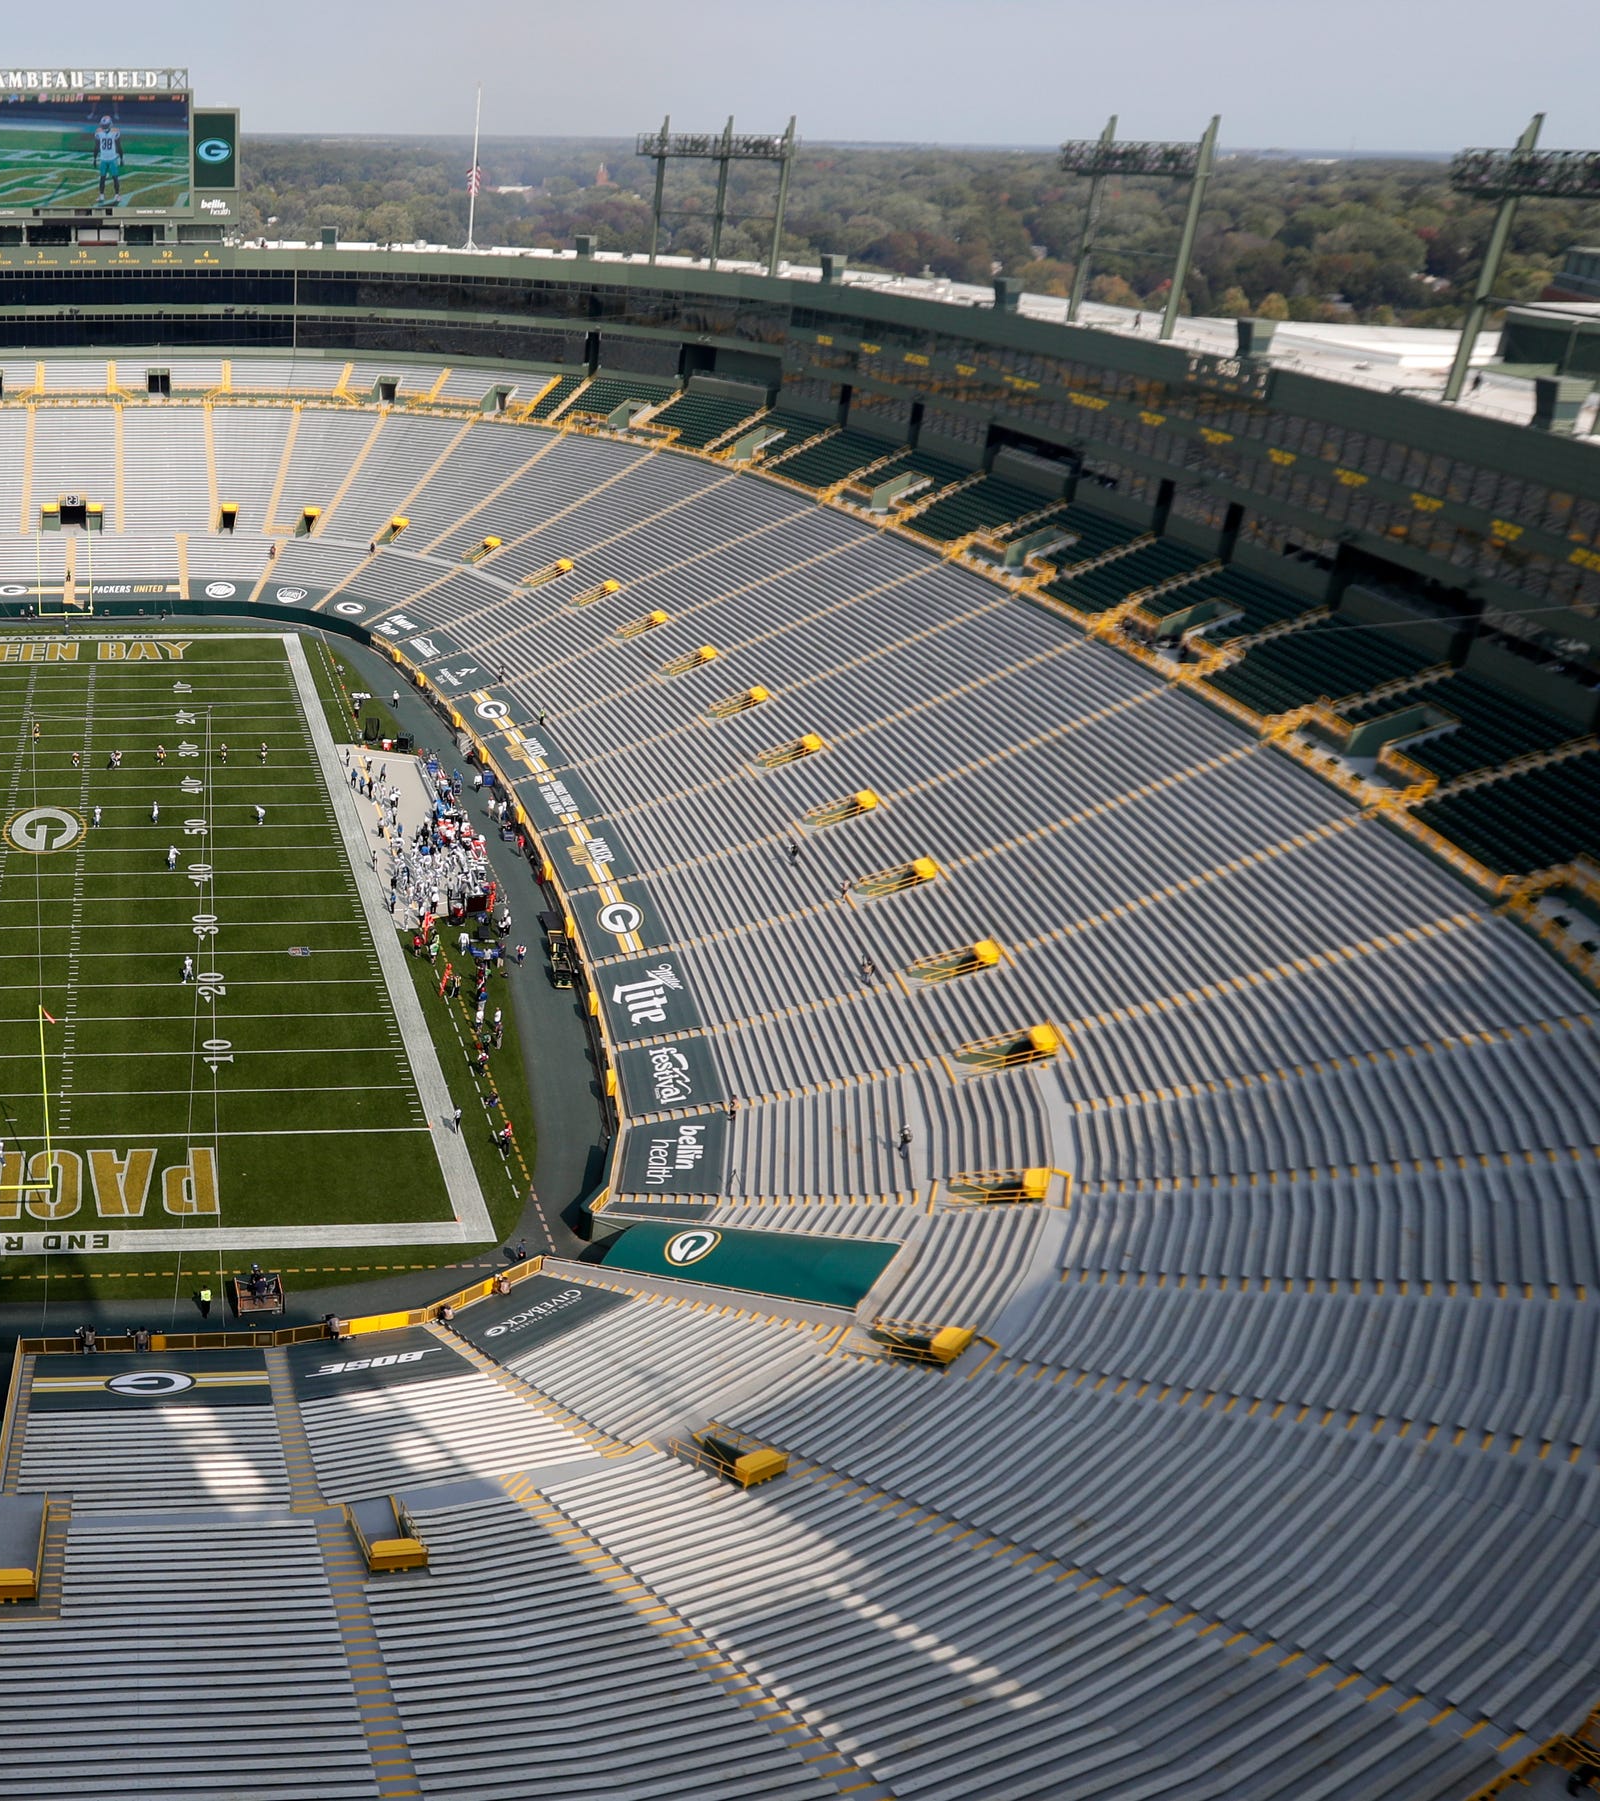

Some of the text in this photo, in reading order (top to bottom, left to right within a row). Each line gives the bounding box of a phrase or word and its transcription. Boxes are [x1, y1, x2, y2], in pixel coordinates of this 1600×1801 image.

[94, 71, 158, 88] FIELD
[196, 138, 233, 164] G
[200, 199, 226, 209] bellin
[210, 207, 231, 216] health
[38, 251, 43, 259] 3
[162, 250, 173, 258] 92
[203, 250, 209, 258] 4
[92, 584, 163, 594] PACKERS UNITED
[338, 603, 363, 613] G
[374, 621, 400, 637] TRIP
[97, 641, 193, 661] BAY
[173, 683, 193, 694] 10
[175, 712, 196, 725] 20
[478, 702, 507, 717] G
[178, 744, 200, 757] 30
[180, 779, 204, 794] 40
[10, 807, 80, 851] G
[184, 819, 208, 835] 50
[585, 837, 615, 865] PACKERS
[188, 863, 213, 883] 40
[191, 914, 219, 935] 30
[601, 904, 639, 932] G
[196, 972, 227, 996] 20
[645, 963, 684, 990] Miller
[612, 972, 668, 1026] Lite
[202, 1039, 235, 1064] 10
[649, 1046, 686, 1105] festival
[675, 1124, 706, 1171] bellin
[645, 1138, 677, 1186] health
[43, 1234, 109, 1250] END
[669, 1231, 716, 1262] G
[501, 1289, 582, 1328] GIVEBACK
[109, 1371, 191, 1395] G
